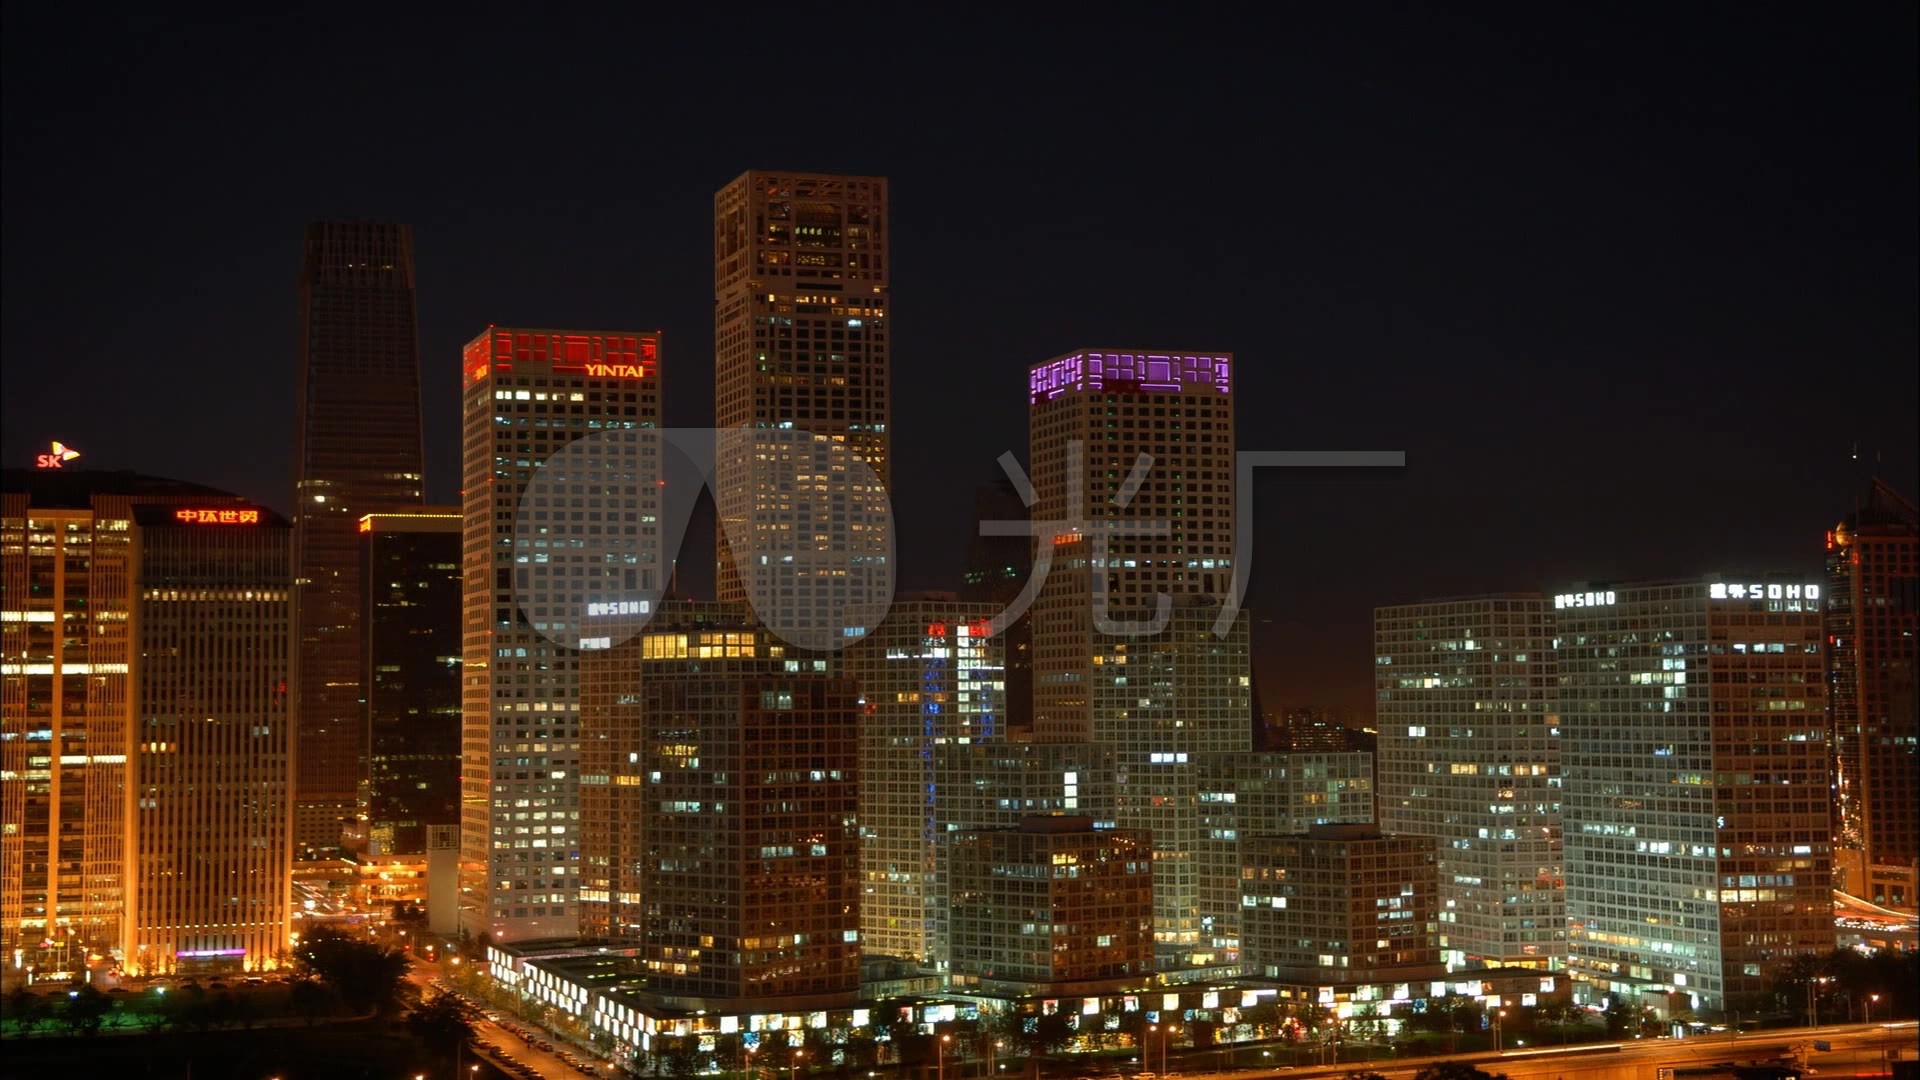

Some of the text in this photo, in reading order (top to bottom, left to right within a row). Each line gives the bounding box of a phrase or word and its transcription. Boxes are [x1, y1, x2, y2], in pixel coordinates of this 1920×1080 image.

[585, 364, 644, 377] YINTAI
[37, 454, 62, 468] SK
[177, 510, 258, 523] 中环世贸
[1710, 583, 1819, 599] 外SOHO
